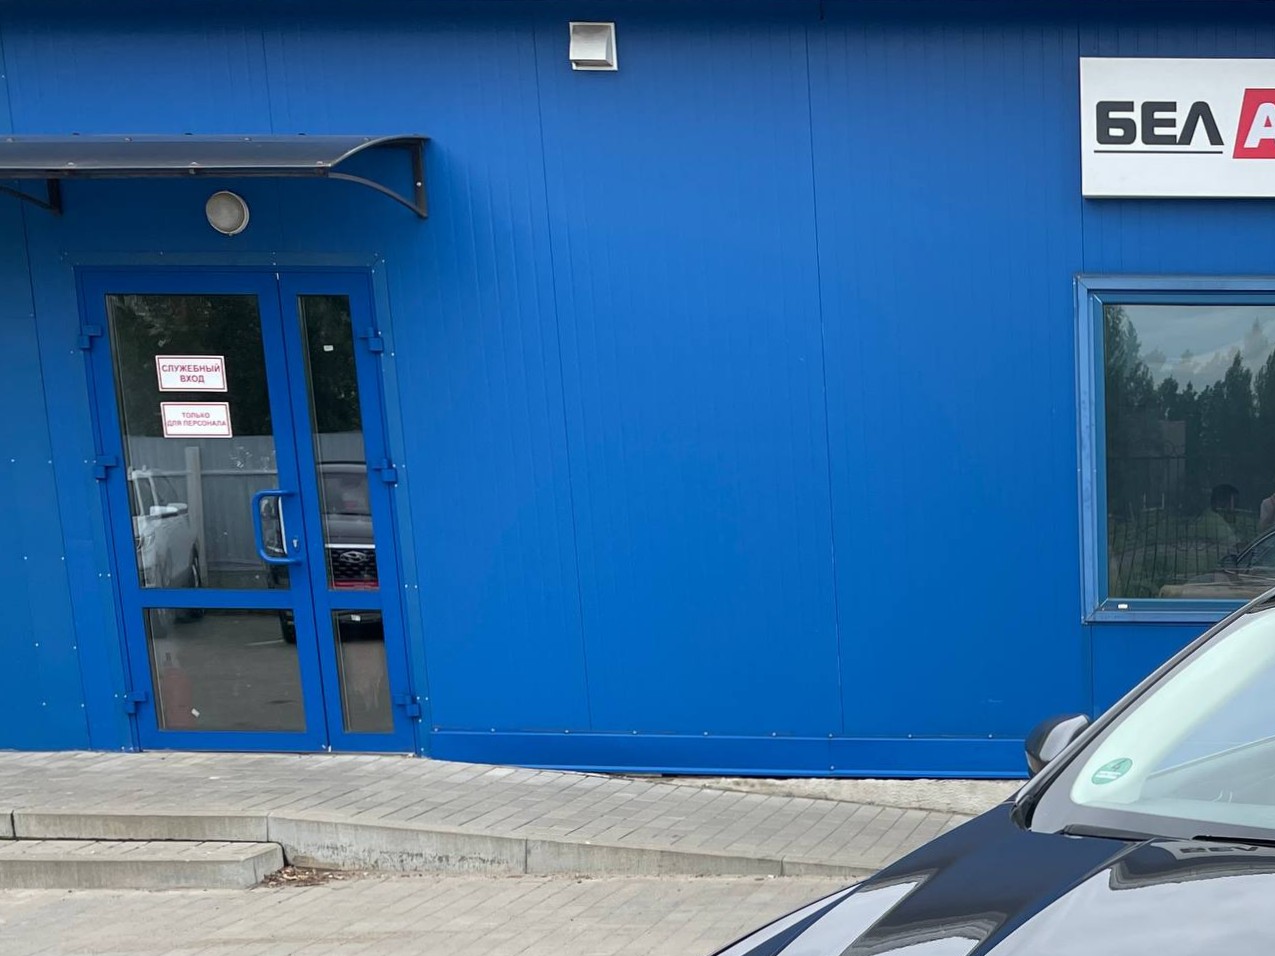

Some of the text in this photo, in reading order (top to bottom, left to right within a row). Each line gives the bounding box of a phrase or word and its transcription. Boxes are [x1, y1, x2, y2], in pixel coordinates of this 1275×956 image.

[1095, 100, 1224, 146] БЕЛ
[161, 363, 221, 373] СЛУЖЕБНЫЙ
[180, 374, 205, 384] ВХОД
